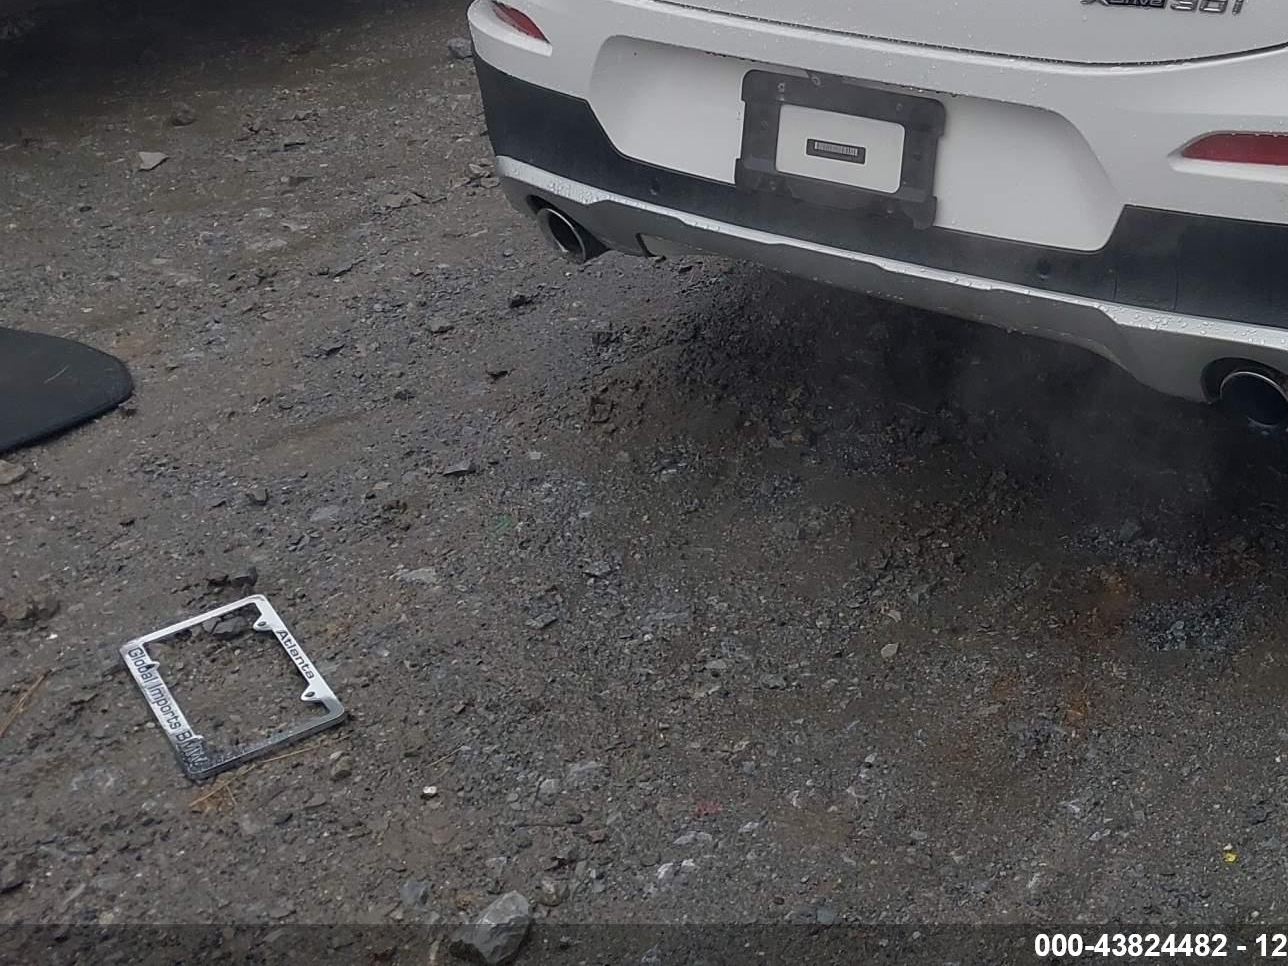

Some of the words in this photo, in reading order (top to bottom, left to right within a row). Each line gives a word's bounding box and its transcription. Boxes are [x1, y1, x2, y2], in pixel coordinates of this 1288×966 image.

[275, 629, 316, 680] Atlanta
[127, 646, 159, 685] Global
[147, 682, 183, 731] Imports
[175, 728, 209, 769] BMW
